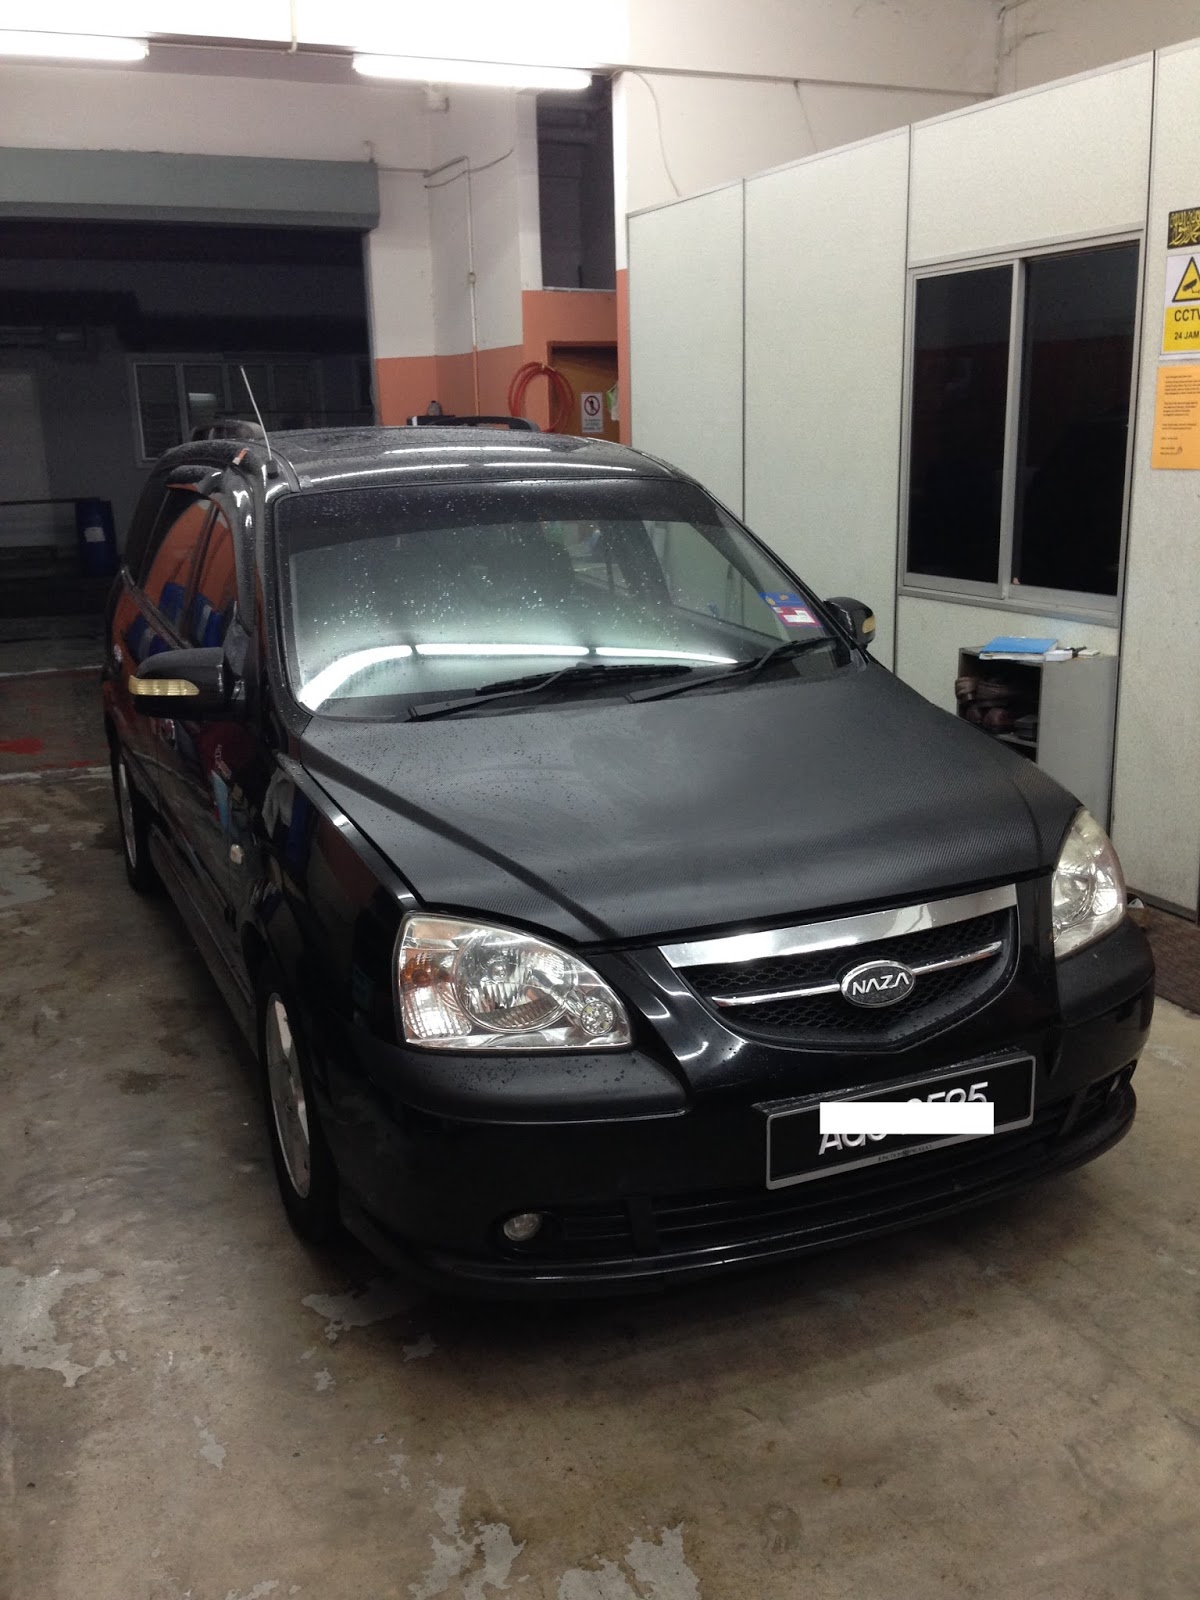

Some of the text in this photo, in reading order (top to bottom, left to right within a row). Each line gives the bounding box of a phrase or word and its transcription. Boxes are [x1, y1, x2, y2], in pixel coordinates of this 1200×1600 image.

[1174, 308, 1200, 322] CCTV
[1174, 330, 1200, 340] 24 JAM
[852, 972, 910, 996] NAZA
